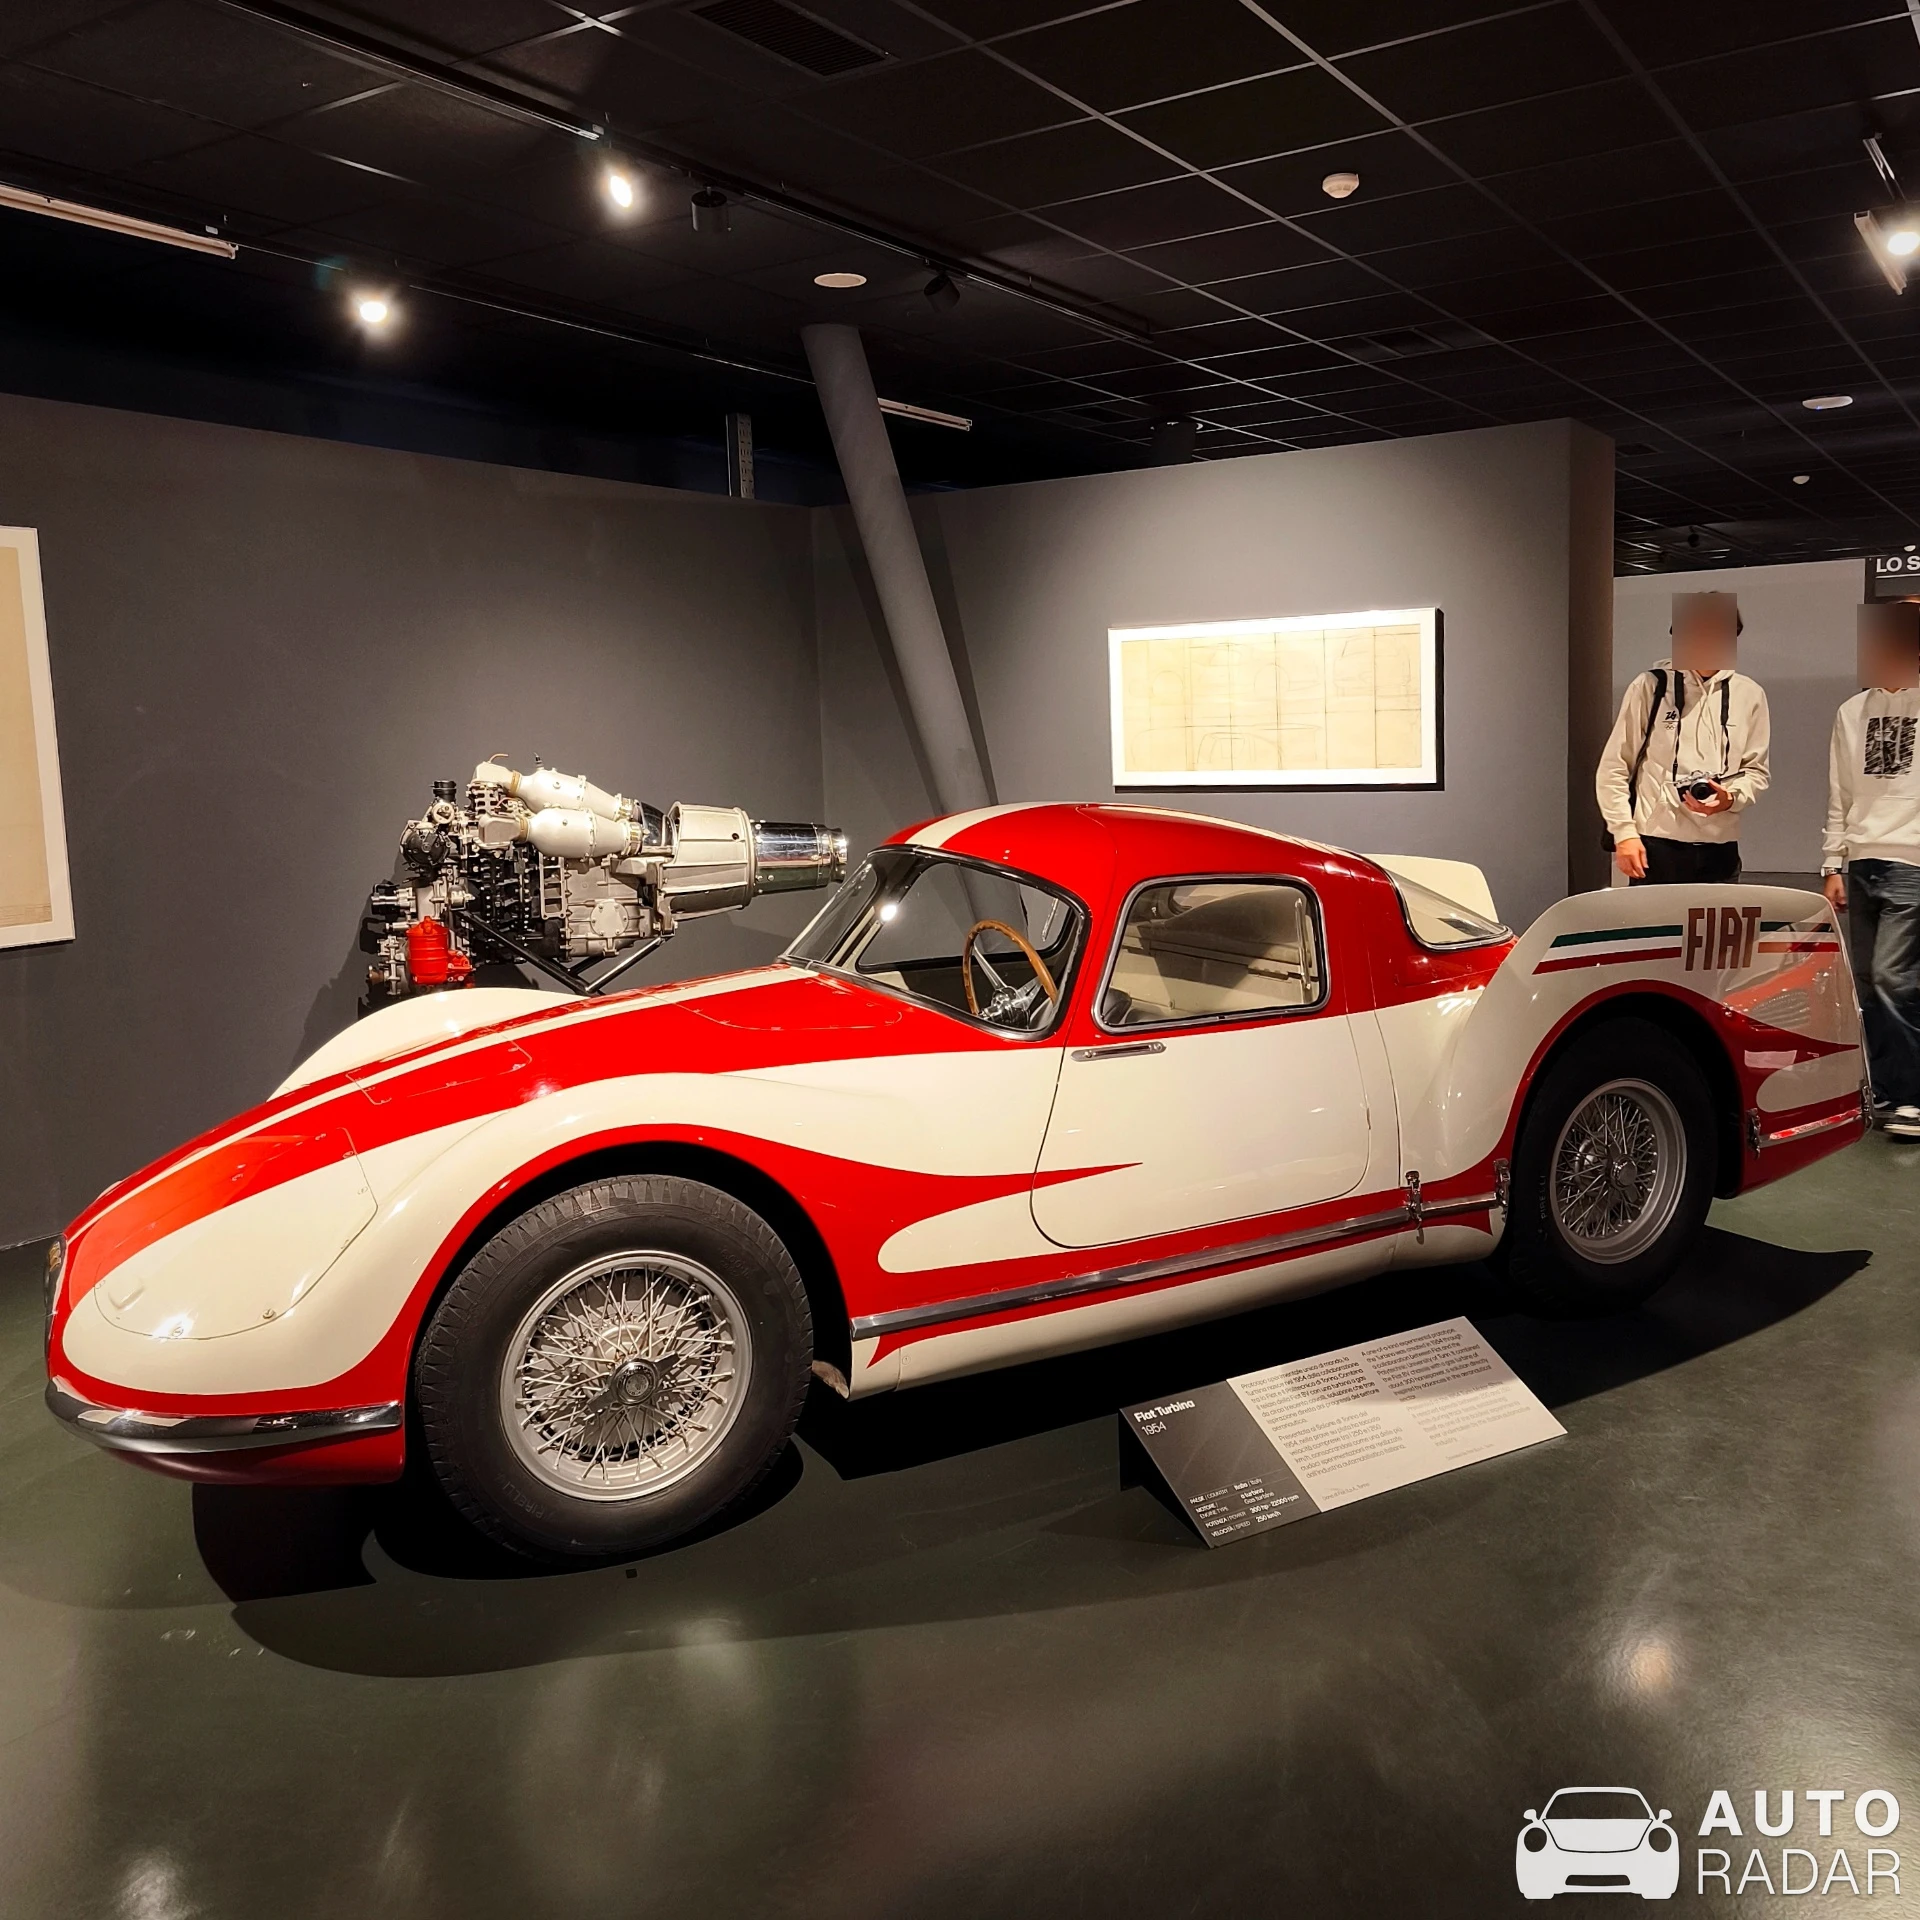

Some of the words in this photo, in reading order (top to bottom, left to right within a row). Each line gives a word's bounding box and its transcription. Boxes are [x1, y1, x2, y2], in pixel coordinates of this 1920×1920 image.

[1876, 556, 1902, 572] LO
[1685, 907, 1761, 971] FIAT
[1134, 1410, 1156, 1422] Fiat
[1155, 1401, 1195, 1415] Turbina
[1142, 1422, 1166, 1435] 1954
